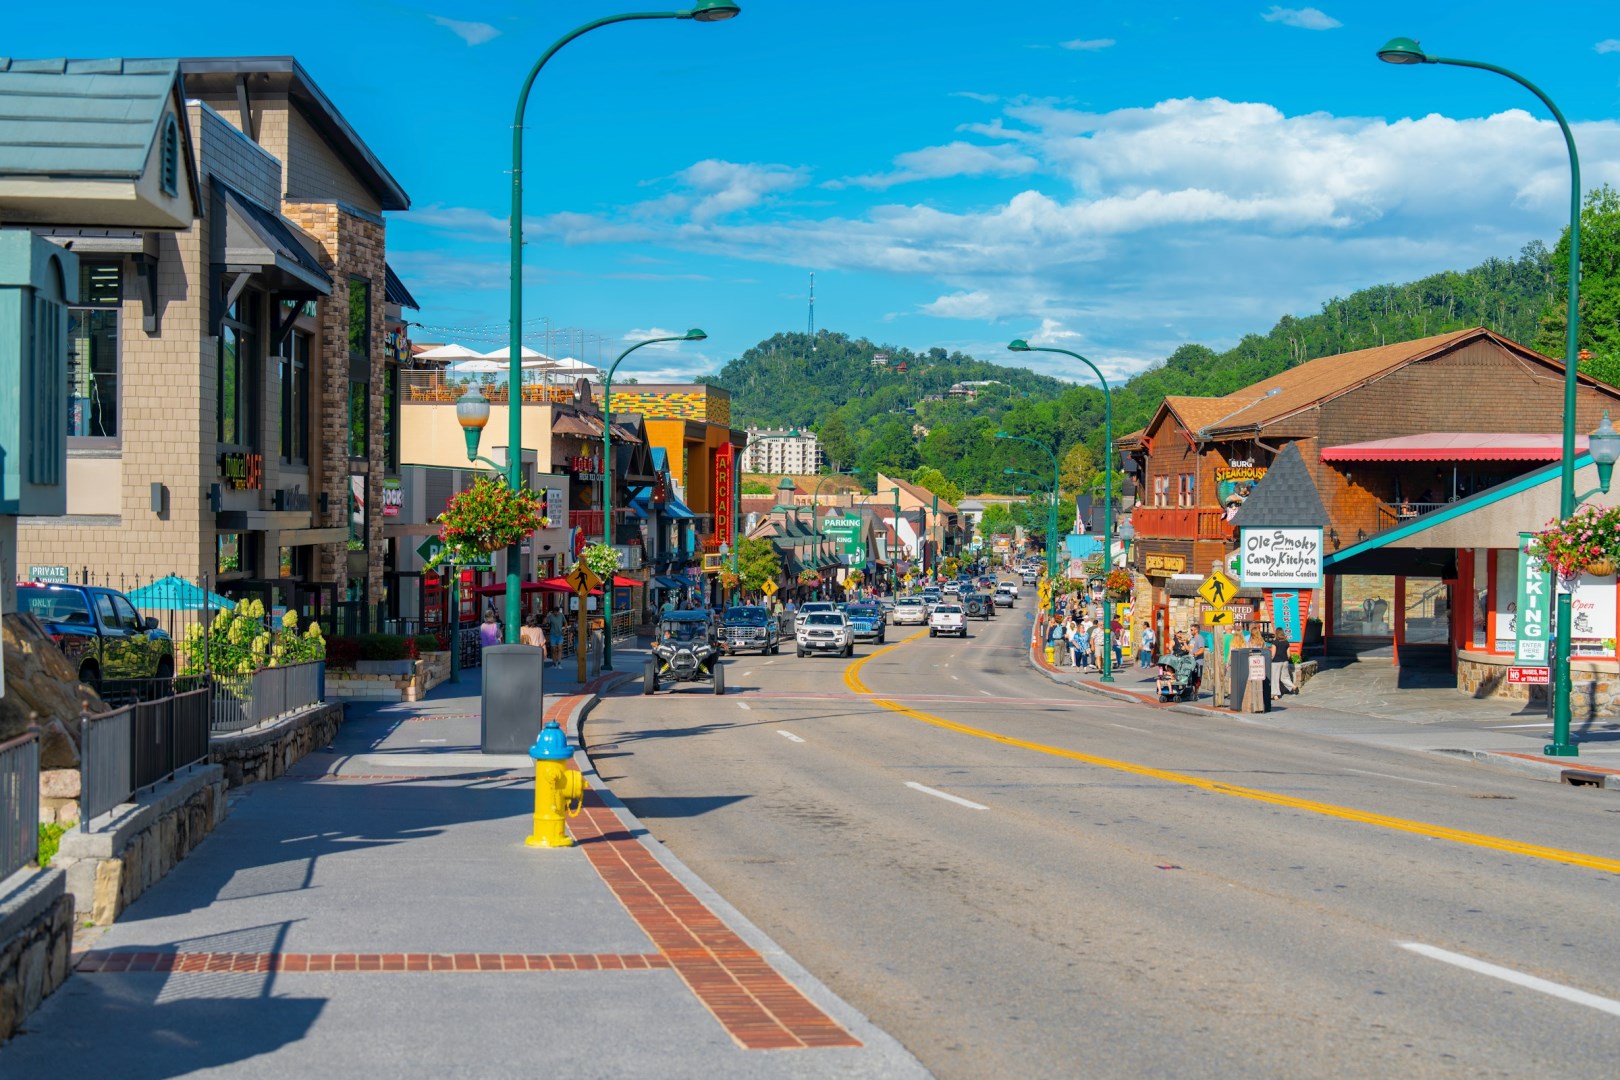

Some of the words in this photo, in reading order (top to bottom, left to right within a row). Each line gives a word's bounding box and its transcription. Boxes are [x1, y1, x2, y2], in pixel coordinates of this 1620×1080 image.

[719, 457, 727, 541] ARCADE
[824, 519, 862, 527] PARKING
[1247, 535, 1271, 551] Ole
[1271, 530, 1317, 556] Smoky
[1246, 552, 1277, 570] Candy
[1276, 551, 1317, 571] Kitchen
[32, 567, 65, 576] PRIVATE
[1295, 570, 1317, 578] Candies
[32, 598, 52, 608] ONLY
[1571, 599, 1595, 611] Open
[1282, 598, 1293, 640] PARKING
[1509, 671, 1520, 680] NO
